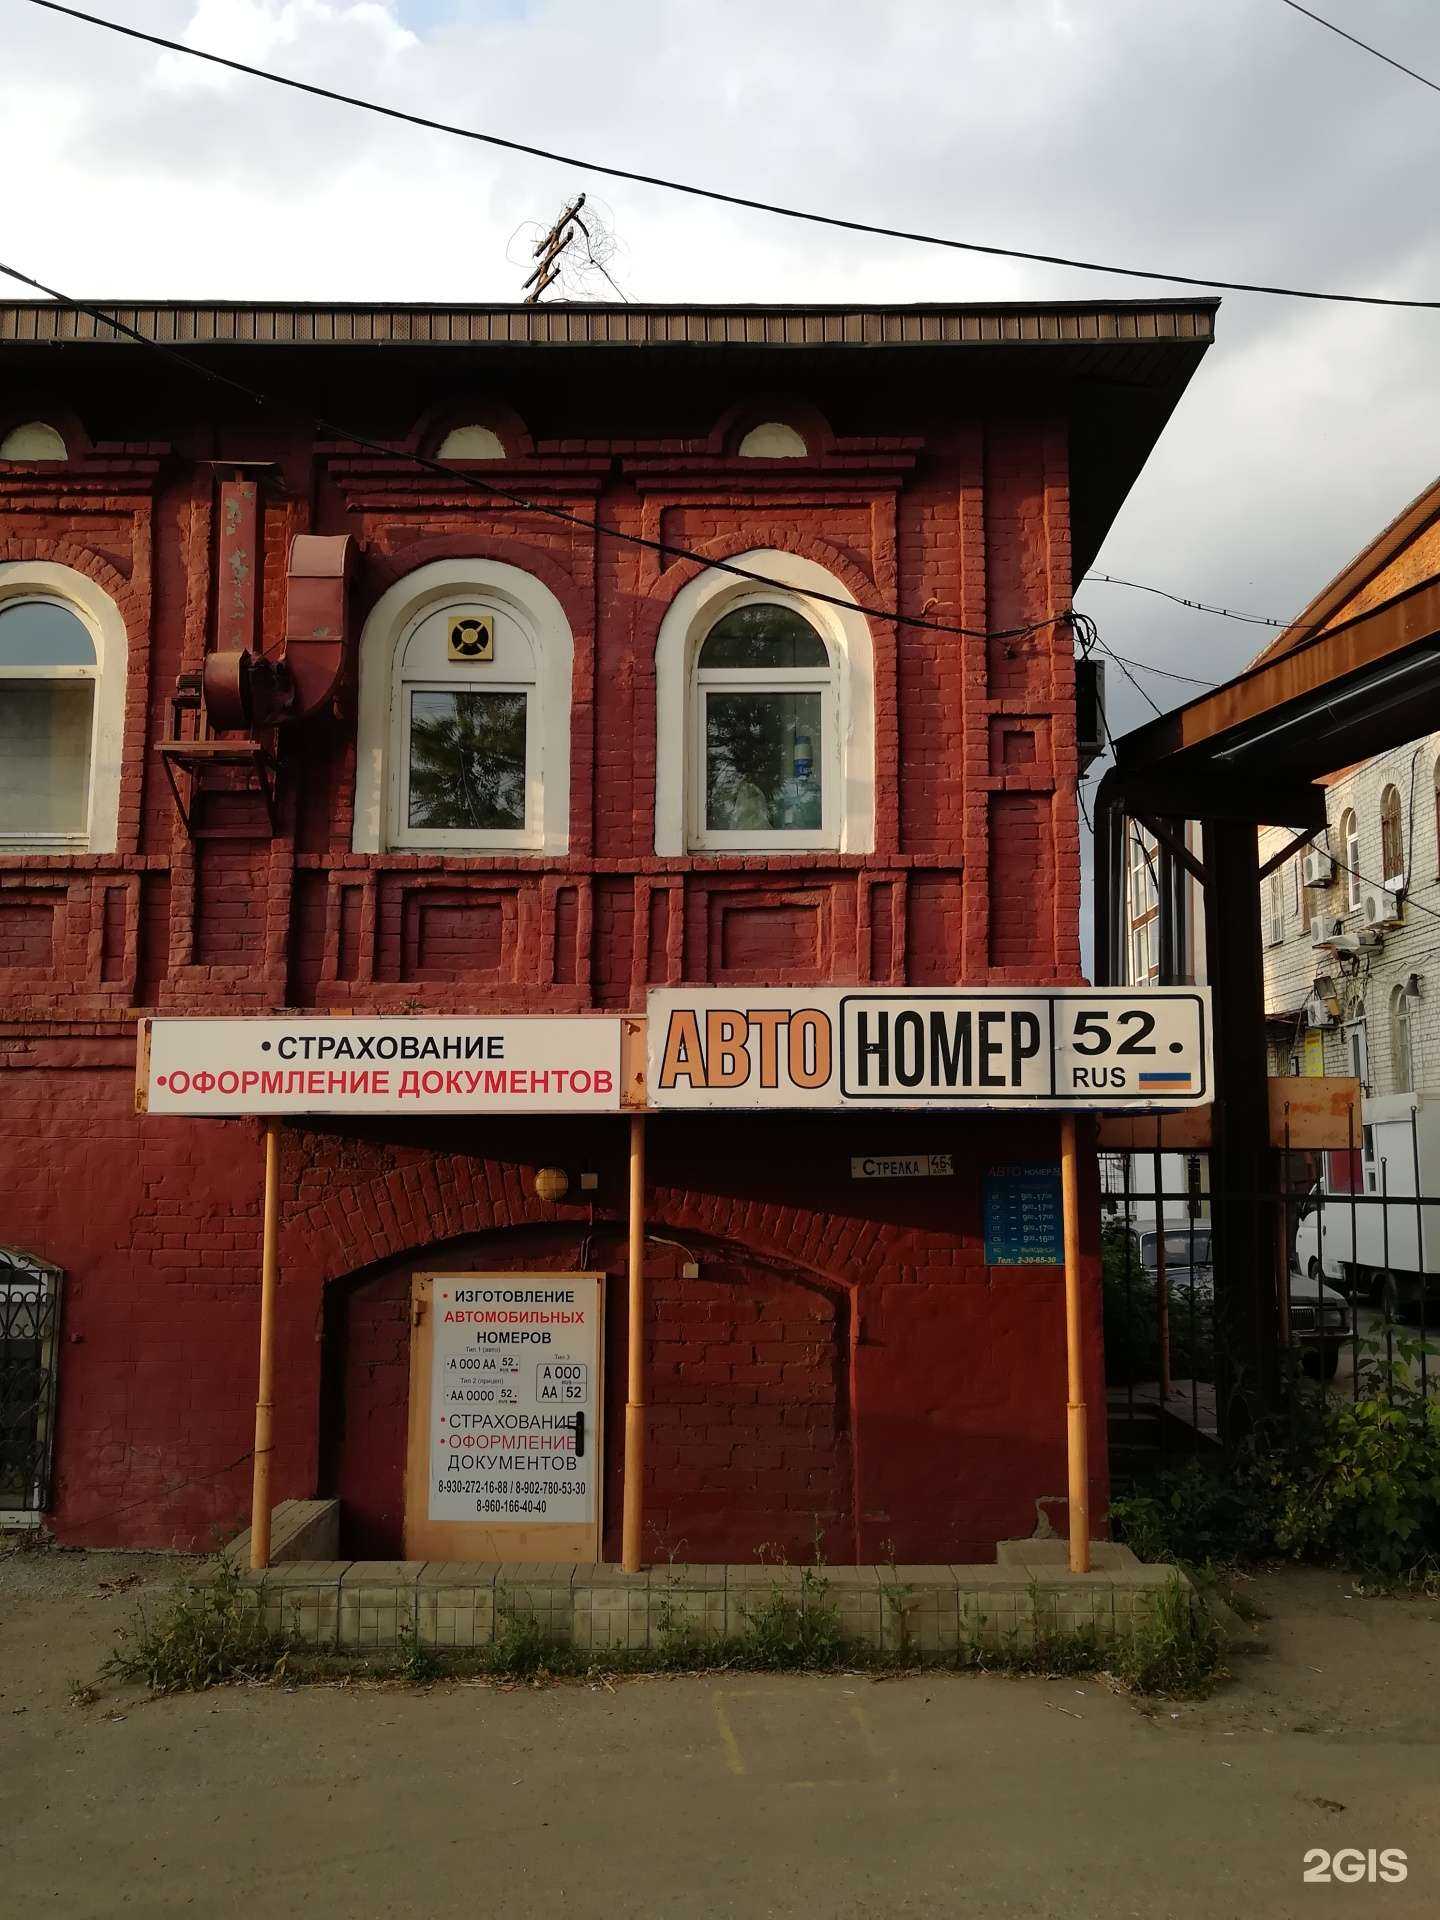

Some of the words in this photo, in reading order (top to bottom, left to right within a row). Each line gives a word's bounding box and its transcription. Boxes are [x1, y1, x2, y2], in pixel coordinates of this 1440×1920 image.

[278, 1036, 504, 1060] СТРАХОВАНИЕ
[658, 1008, 833, 1090] АВТО
[857, 1010, 1041, 1088] НОМЕР
[168, 1070, 389, 1094] ОФОРМЛЕНИЕ
[398, 1070, 613, 1098] ДОКУМЕНТОВ
[1073, 1066, 1126, 1089] RUS
[455, 1290, 574, 1303] ИЗГОТОВЛЕНИЕ
[444, 1311, 585, 1324] АВТОМОБИЛЬНЫХ
[477, 1331, 552, 1344] НОМЕРОВ
[554, 1366, 581, 1379] 000
[541, 1386, 558, 1399] АА
[566, 1386, 582, 1399] 52
[449, 1414, 577, 1429] СТРАХОВАНИЕ
[449, 1434, 577, 1450] ОФОРМЛЕНИЕ
[448, 1454, 577, 1472] ДОКУМЕНТОВ
[438, 1480, 508, 1494] 8-930-272-16-88
[515, 1482, 586, 1495] 8-902-780-53-30
[476, 1499, 547, 1513] 8-960-166-40-40
